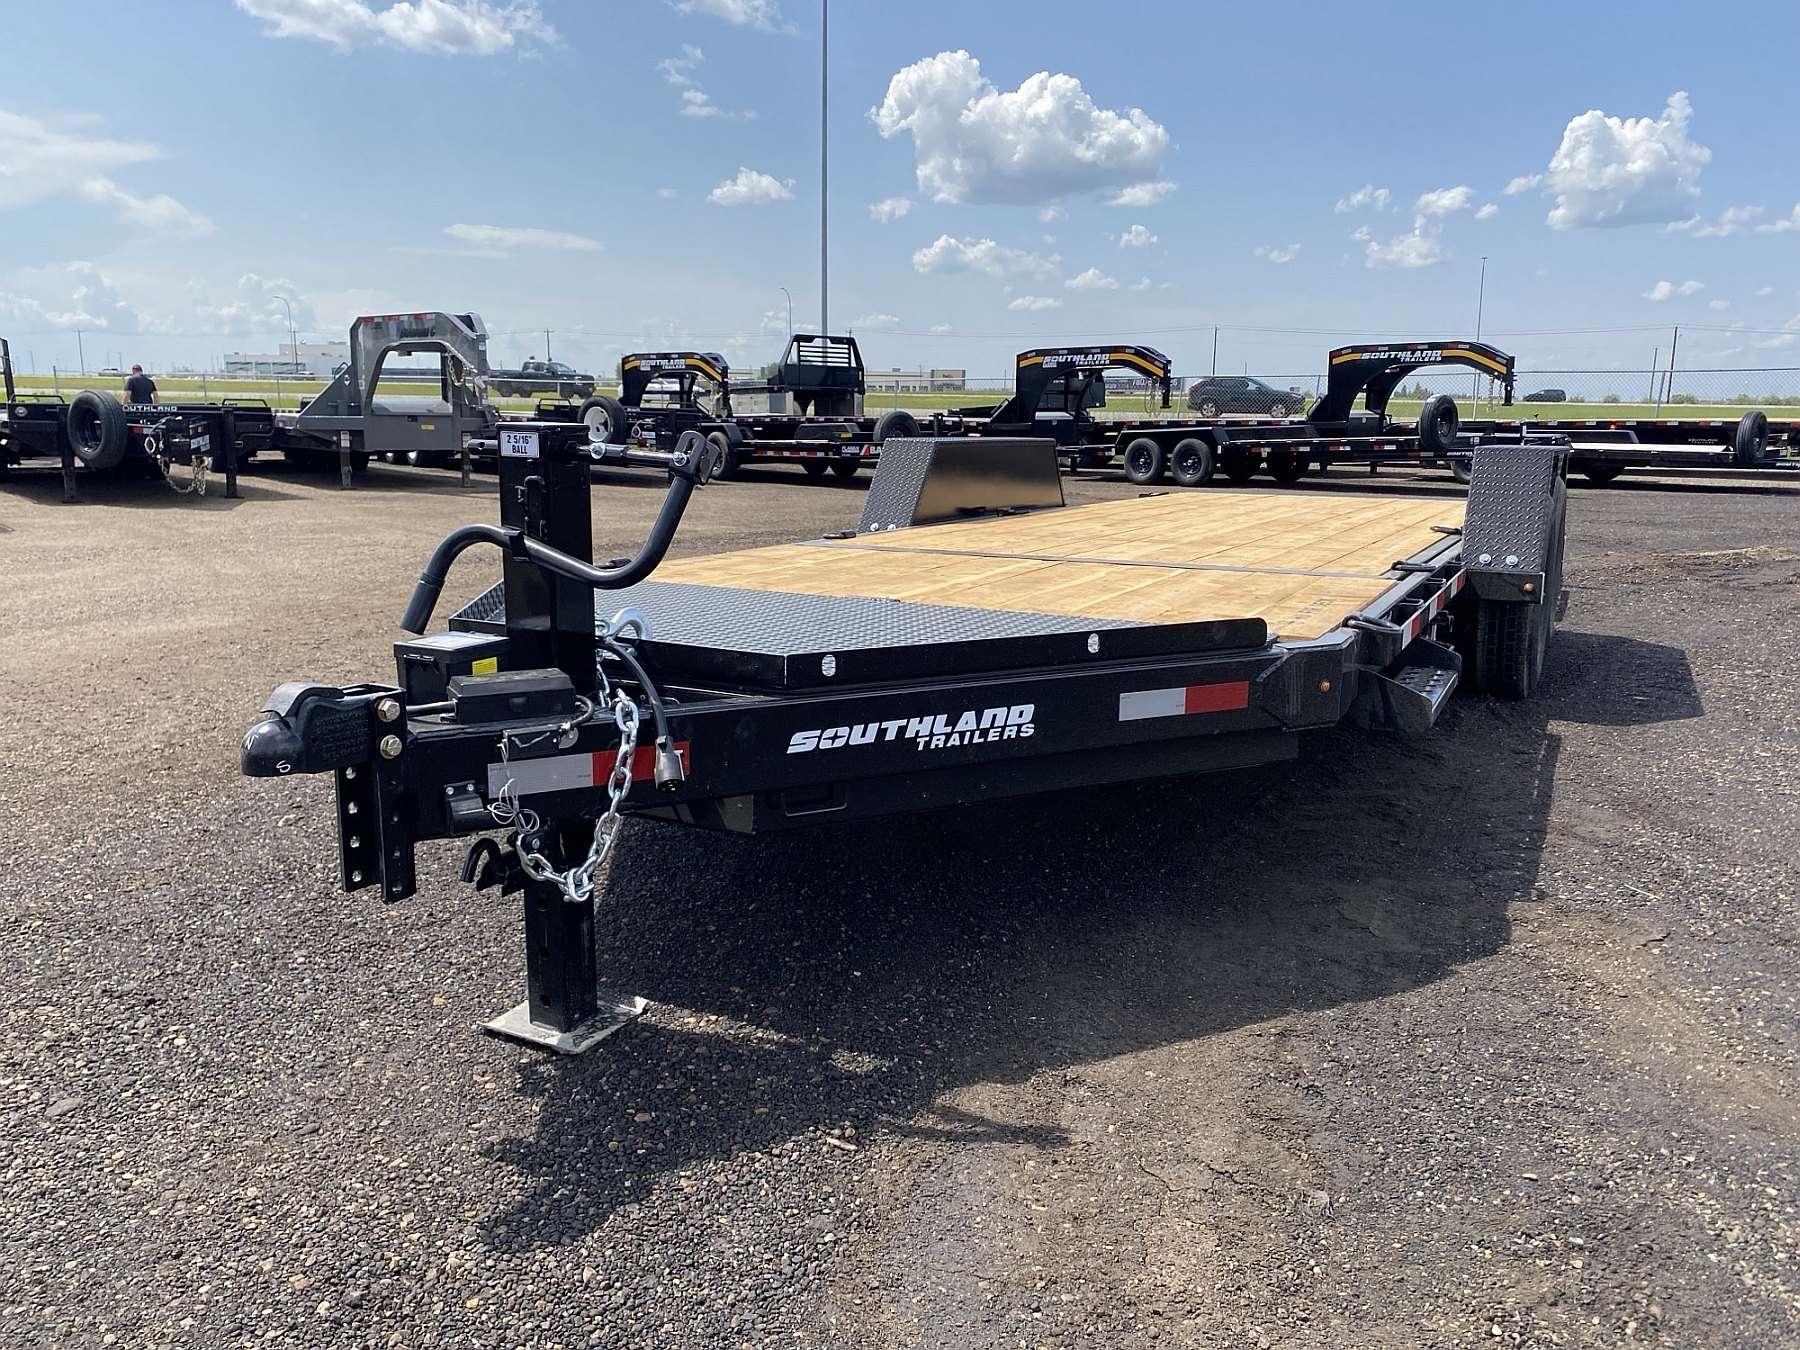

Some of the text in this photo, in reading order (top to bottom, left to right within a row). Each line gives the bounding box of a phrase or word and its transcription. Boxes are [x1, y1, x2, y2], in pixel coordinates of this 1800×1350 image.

[1043, 353, 1110, 364] SOUTHLAND
[1361, 350, 1442, 360] SOUTHLAND
[506, 434, 532, 445] 2 5/16"
[511, 444, 528, 454] BALL
[786, 704, 1035, 754] SOUTHLAND
[915, 723, 1035, 751] TRAILERS
